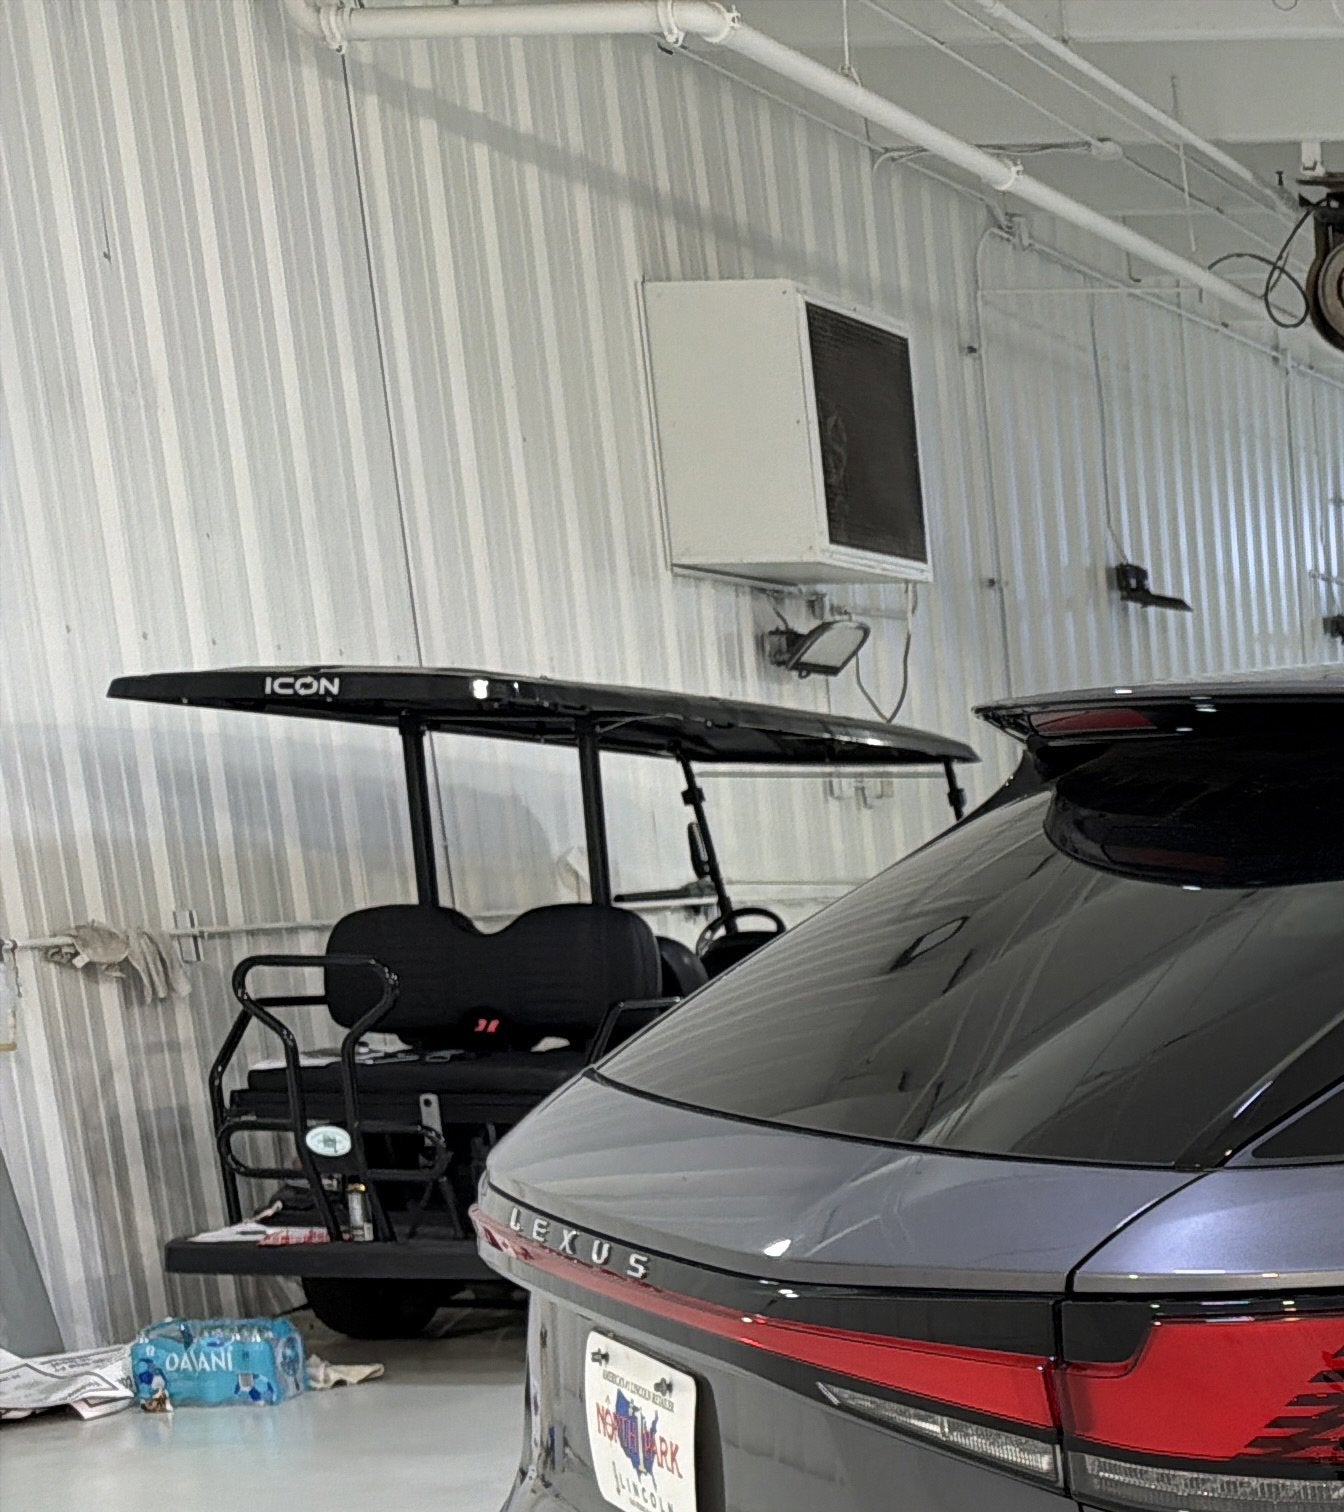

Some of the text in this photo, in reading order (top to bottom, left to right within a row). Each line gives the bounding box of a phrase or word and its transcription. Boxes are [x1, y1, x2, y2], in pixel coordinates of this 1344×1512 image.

[264, 676, 340, 696] ICON
[508, 1206, 649, 1280] LEXUS
[596, 1401, 683, 1479] NORTH PARK
